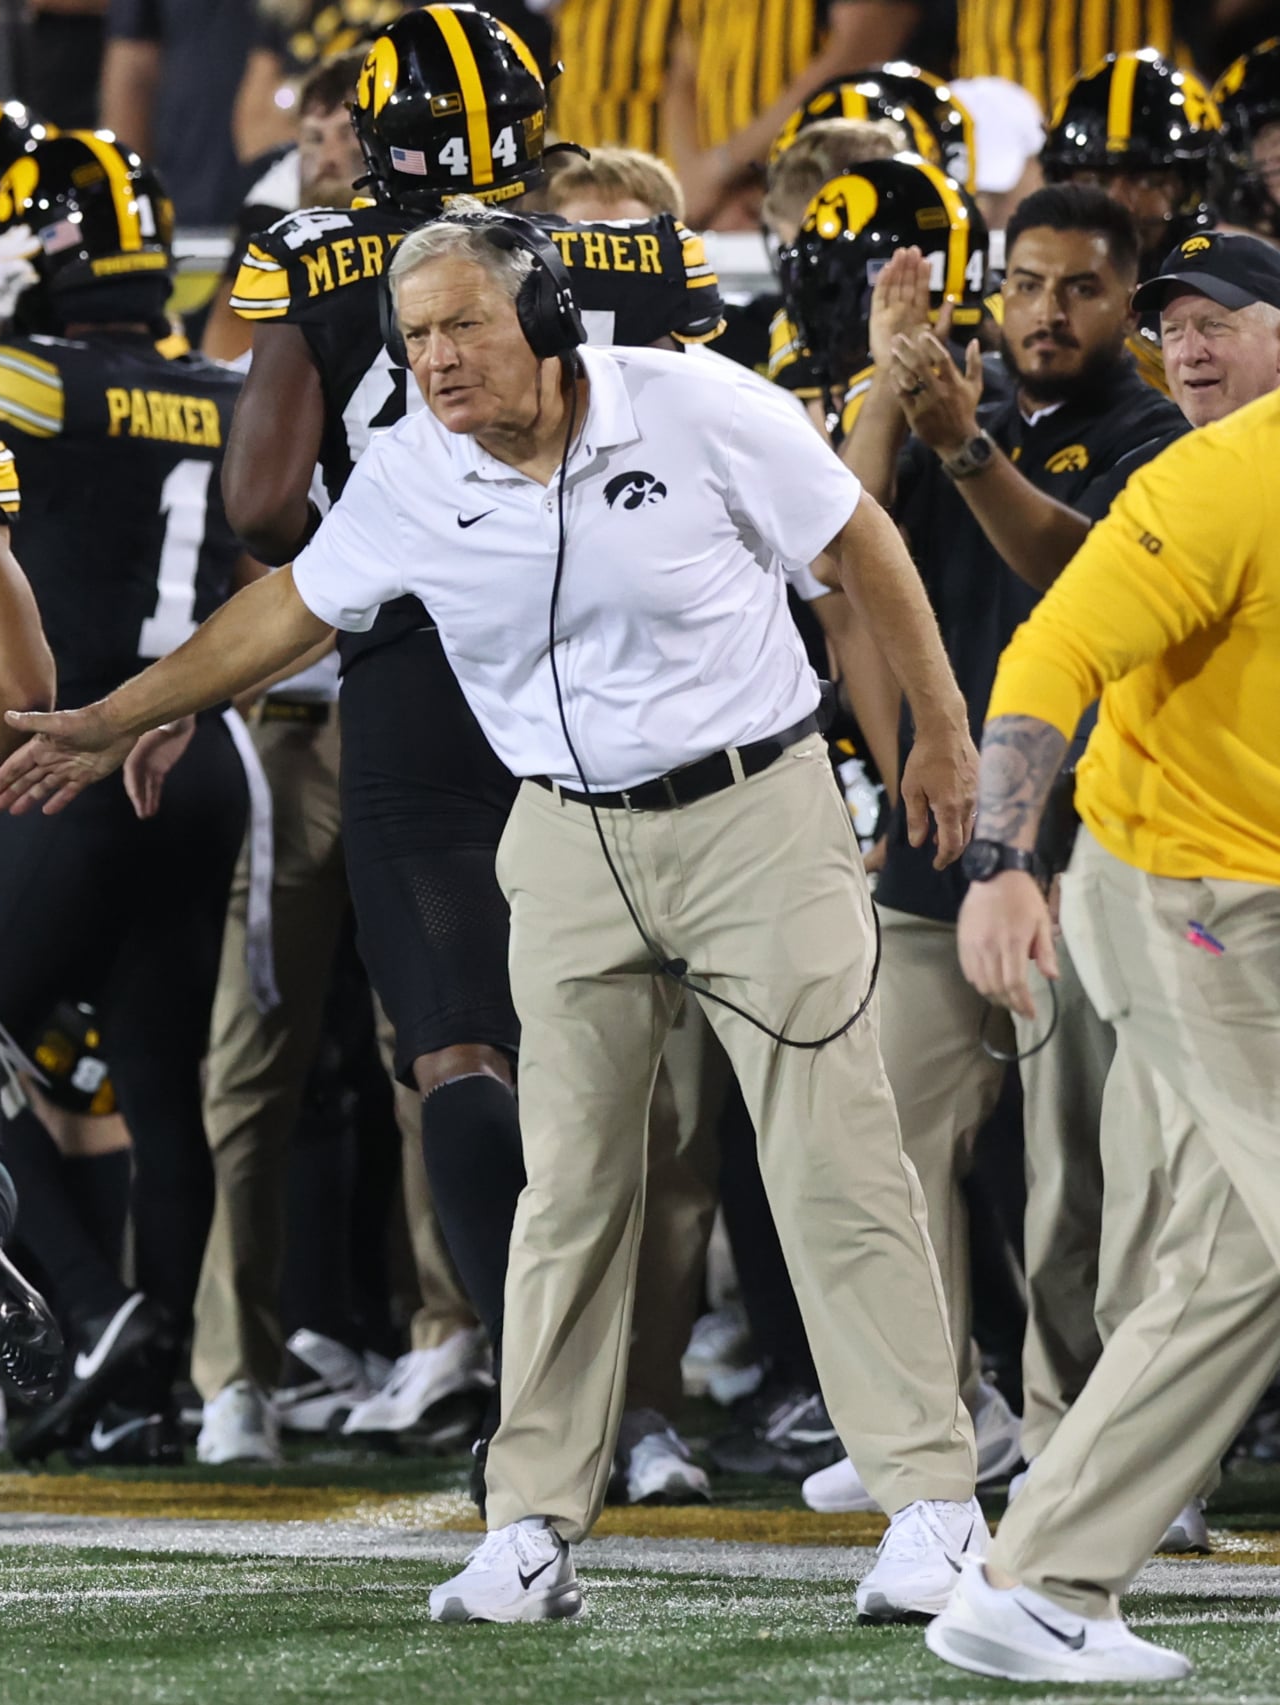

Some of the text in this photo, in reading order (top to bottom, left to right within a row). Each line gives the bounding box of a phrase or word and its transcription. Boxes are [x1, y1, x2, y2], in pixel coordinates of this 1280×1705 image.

[439, 126, 517, 176] 44
[105, 387, 222, 448] PARKER
[137, 458, 214, 658] 1
